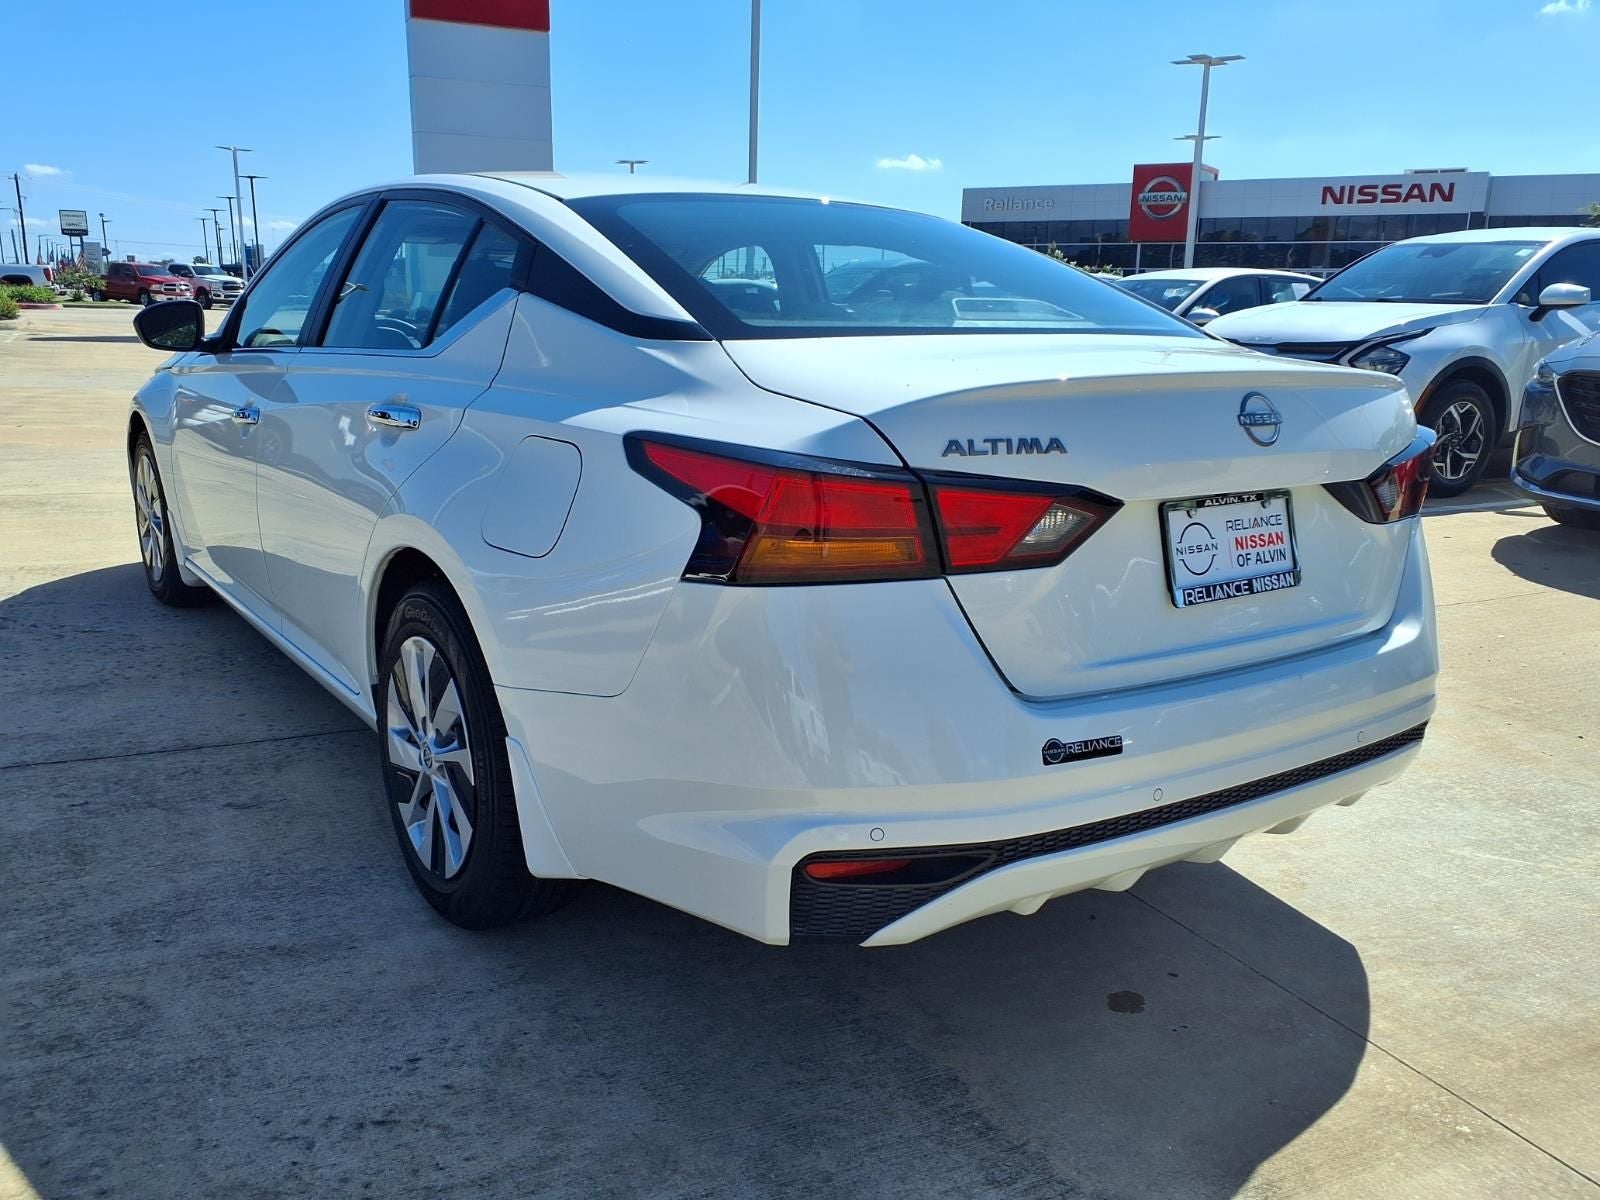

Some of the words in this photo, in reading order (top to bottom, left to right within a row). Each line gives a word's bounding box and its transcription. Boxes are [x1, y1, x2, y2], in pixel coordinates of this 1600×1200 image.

[1141, 194, 1183, 202] NISSAN
[1321, 182, 1455, 205] NISSAN
[983, 196, 1056, 211] Reliance
[1239, 413, 1282, 425] NISSAN
[942, 437, 1068, 457] ALTIMA
[1242, 494, 1257, 502] TX
[1225, 514, 1283, 532] RELIANCE
[1176, 542, 1218, 556] NISSAN
[1234, 532, 1285, 551] NISSAN
[1236, 553, 1252, 568] OF
[1255, 547, 1287, 565] ALVIN
[1184, 580, 1250, 605] RELIANCE
[1252, 572, 1295, 593] NISSAN
[1065, 736, 1122, 754] RELIANCE
